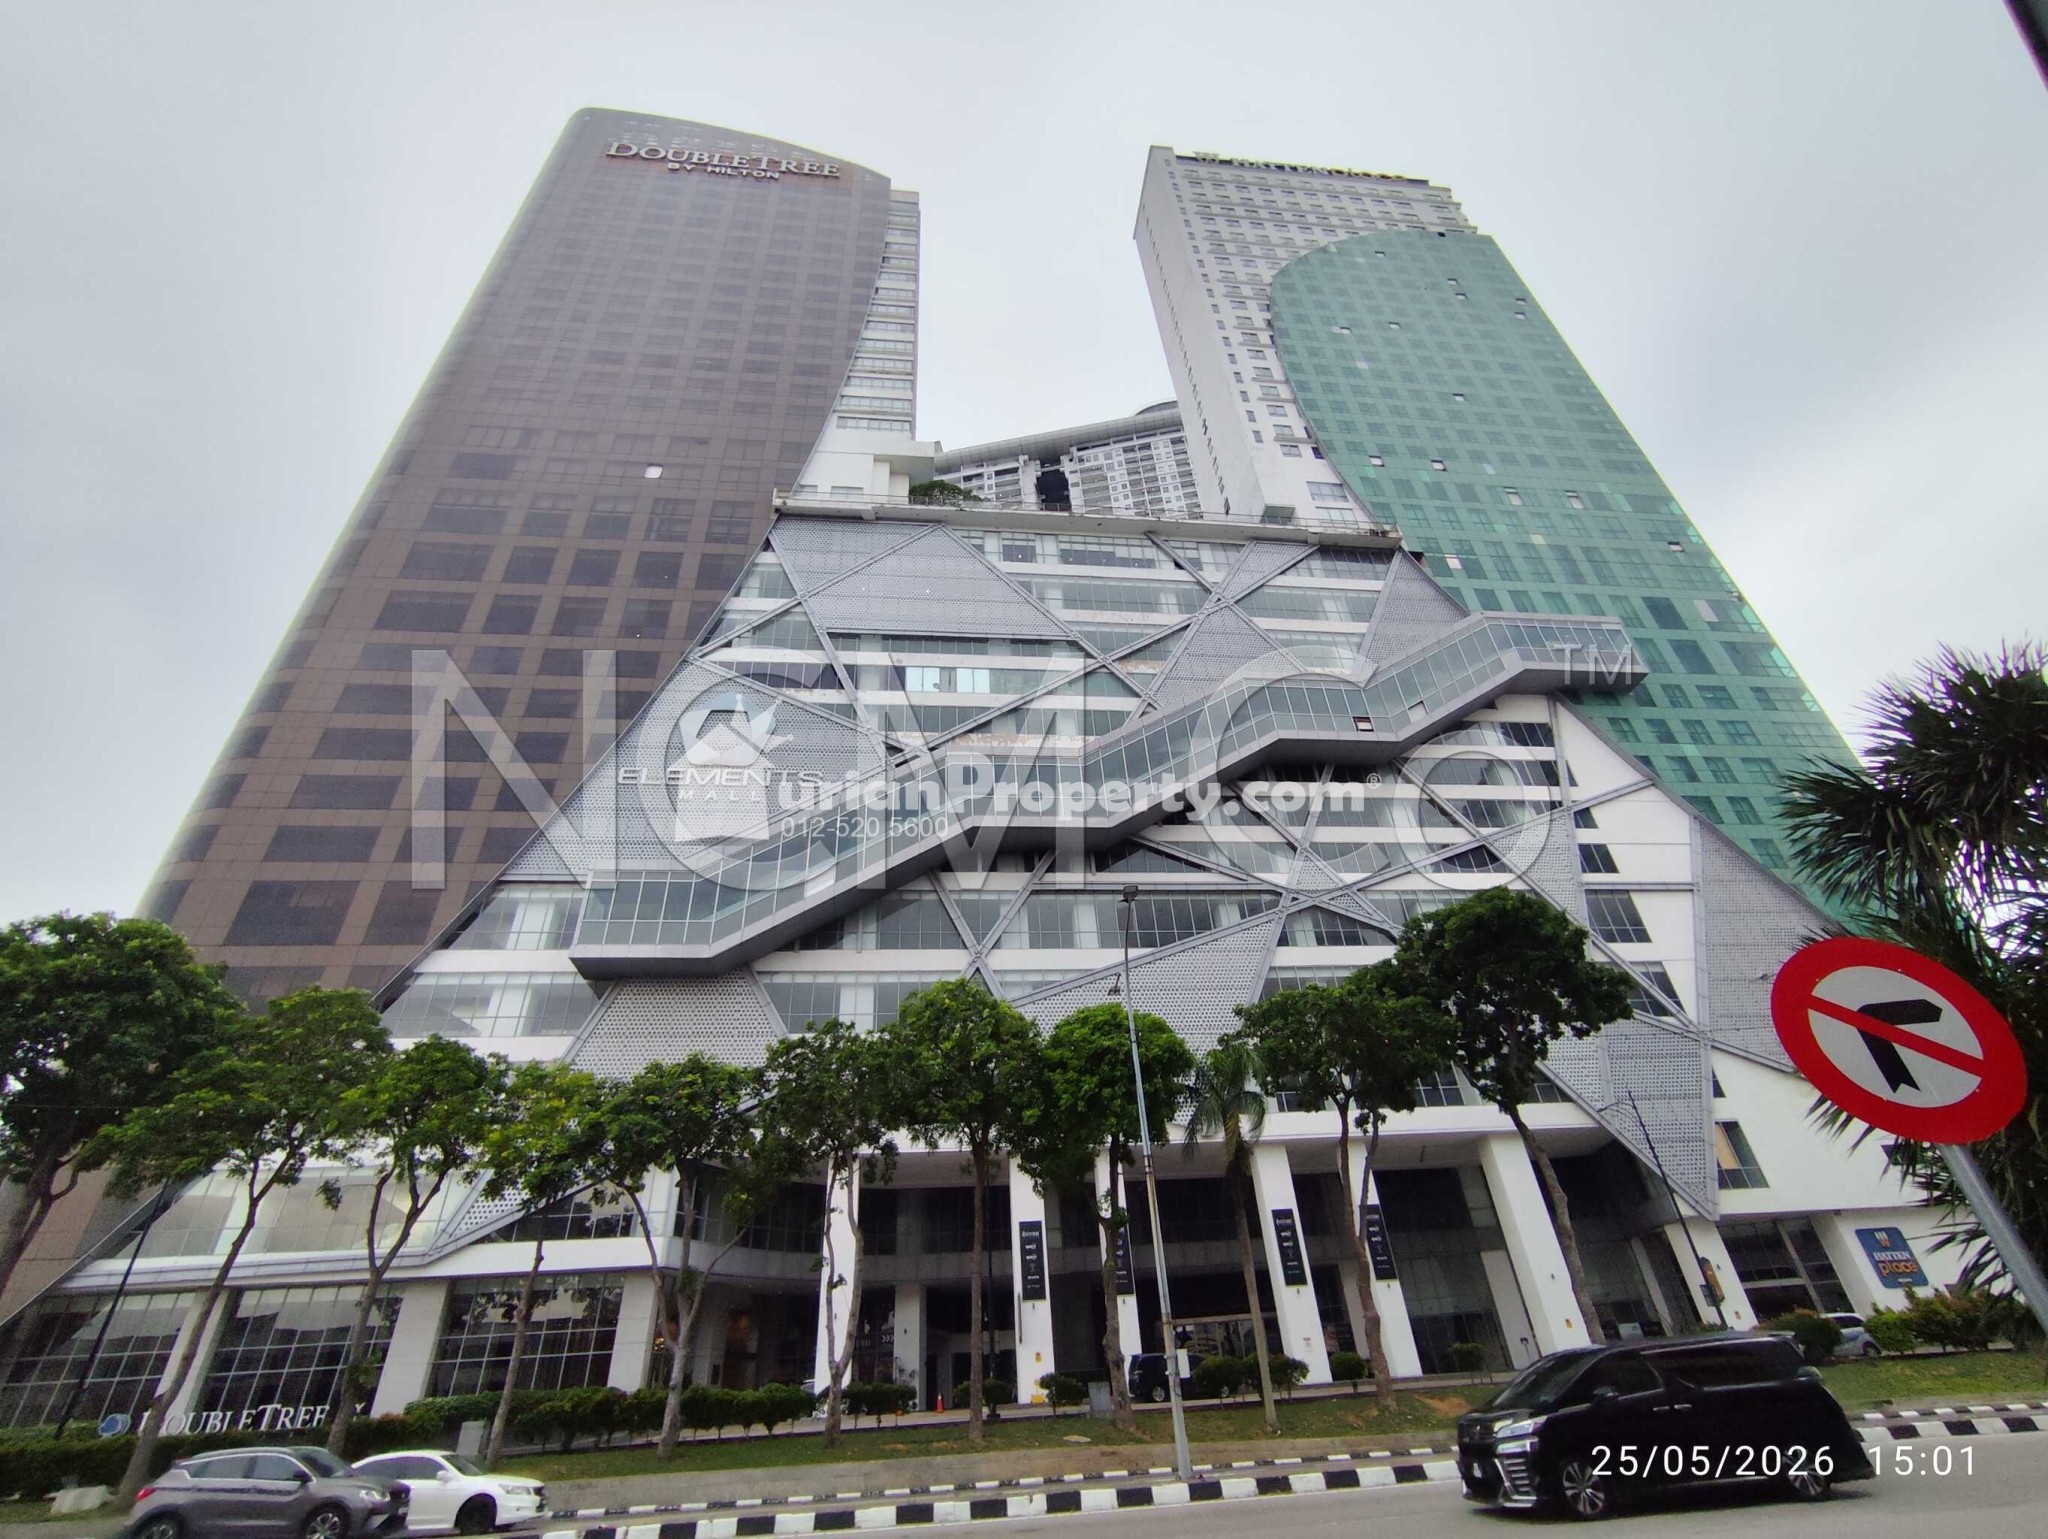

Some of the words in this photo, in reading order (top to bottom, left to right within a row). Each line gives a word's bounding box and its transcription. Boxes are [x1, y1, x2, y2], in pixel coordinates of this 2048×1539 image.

[606, 141, 841, 177] DOUBLETREE
[667, 162, 696, 171] BY
[707, 166, 780, 179] HILTON
[618, 767, 824, 788] ELEMENTS
[679, 790, 761, 801] MALL
[1872, 1250, 1912, 1261] HATTEN
[1878, 1259, 1919, 1277] place
